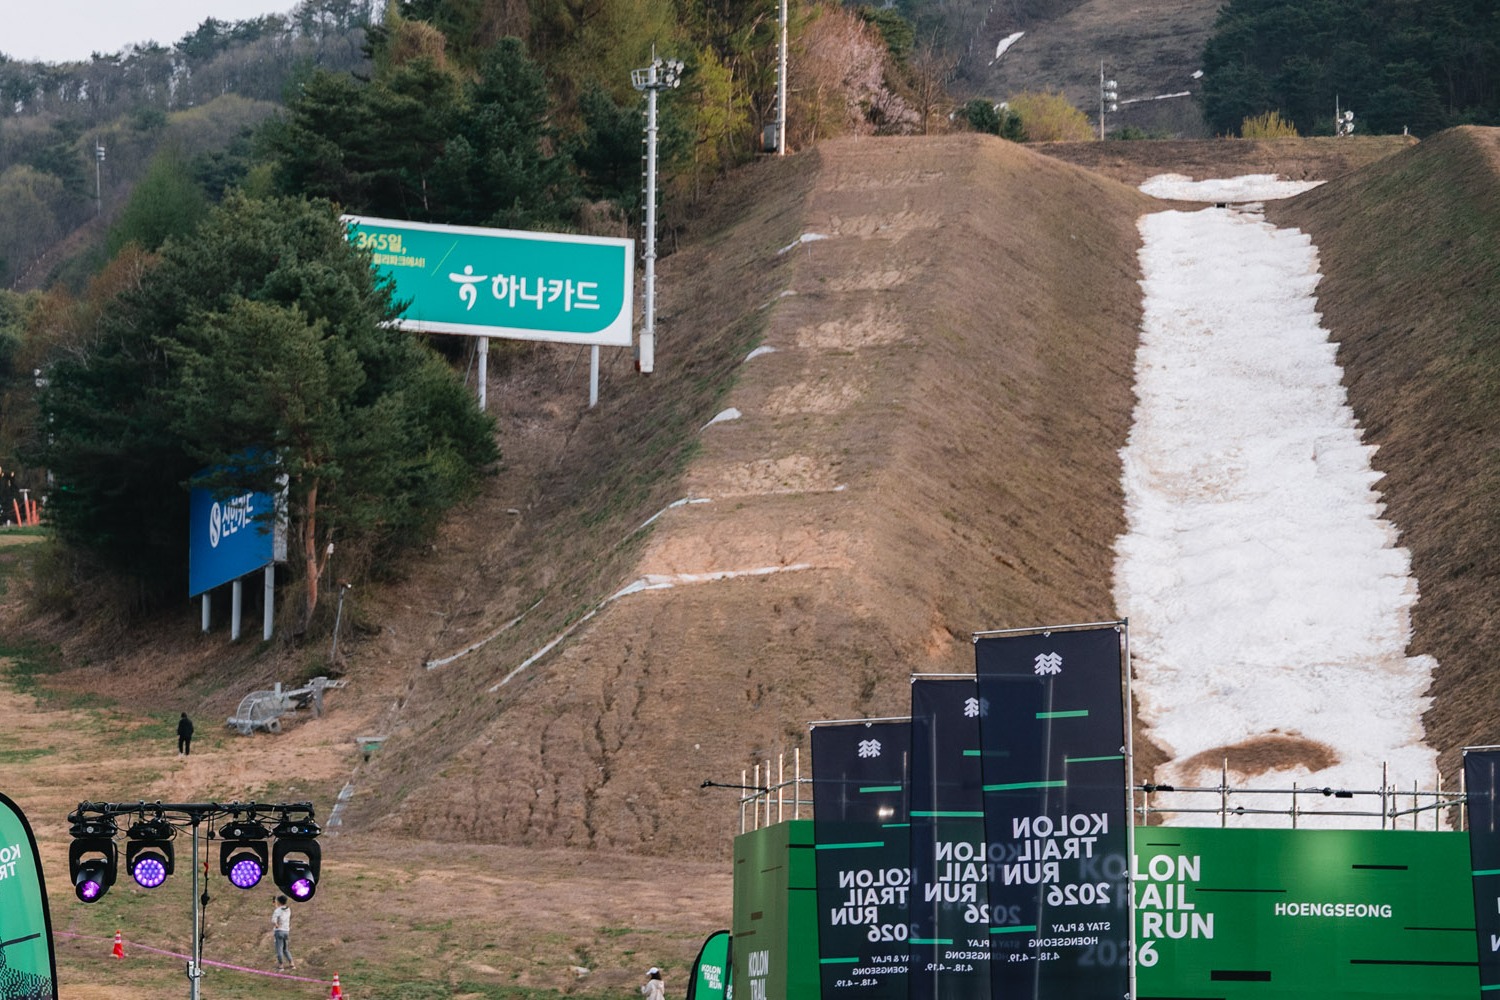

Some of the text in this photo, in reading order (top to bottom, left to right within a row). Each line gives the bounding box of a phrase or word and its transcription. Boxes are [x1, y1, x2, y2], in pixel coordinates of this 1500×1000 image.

[357, 231, 407, 255] 365일,
[492, 273, 600, 312] 하나카드
[1274, 902, 1392, 918] HOENGSEONG
[1142, 912, 1214, 939] RUN
[700, 963, 722, 975] KOLON
[748, 950, 769, 978] KOLON
[703, 972, 720, 983] TRAIL
[708, 980, 723, 990] RUN
